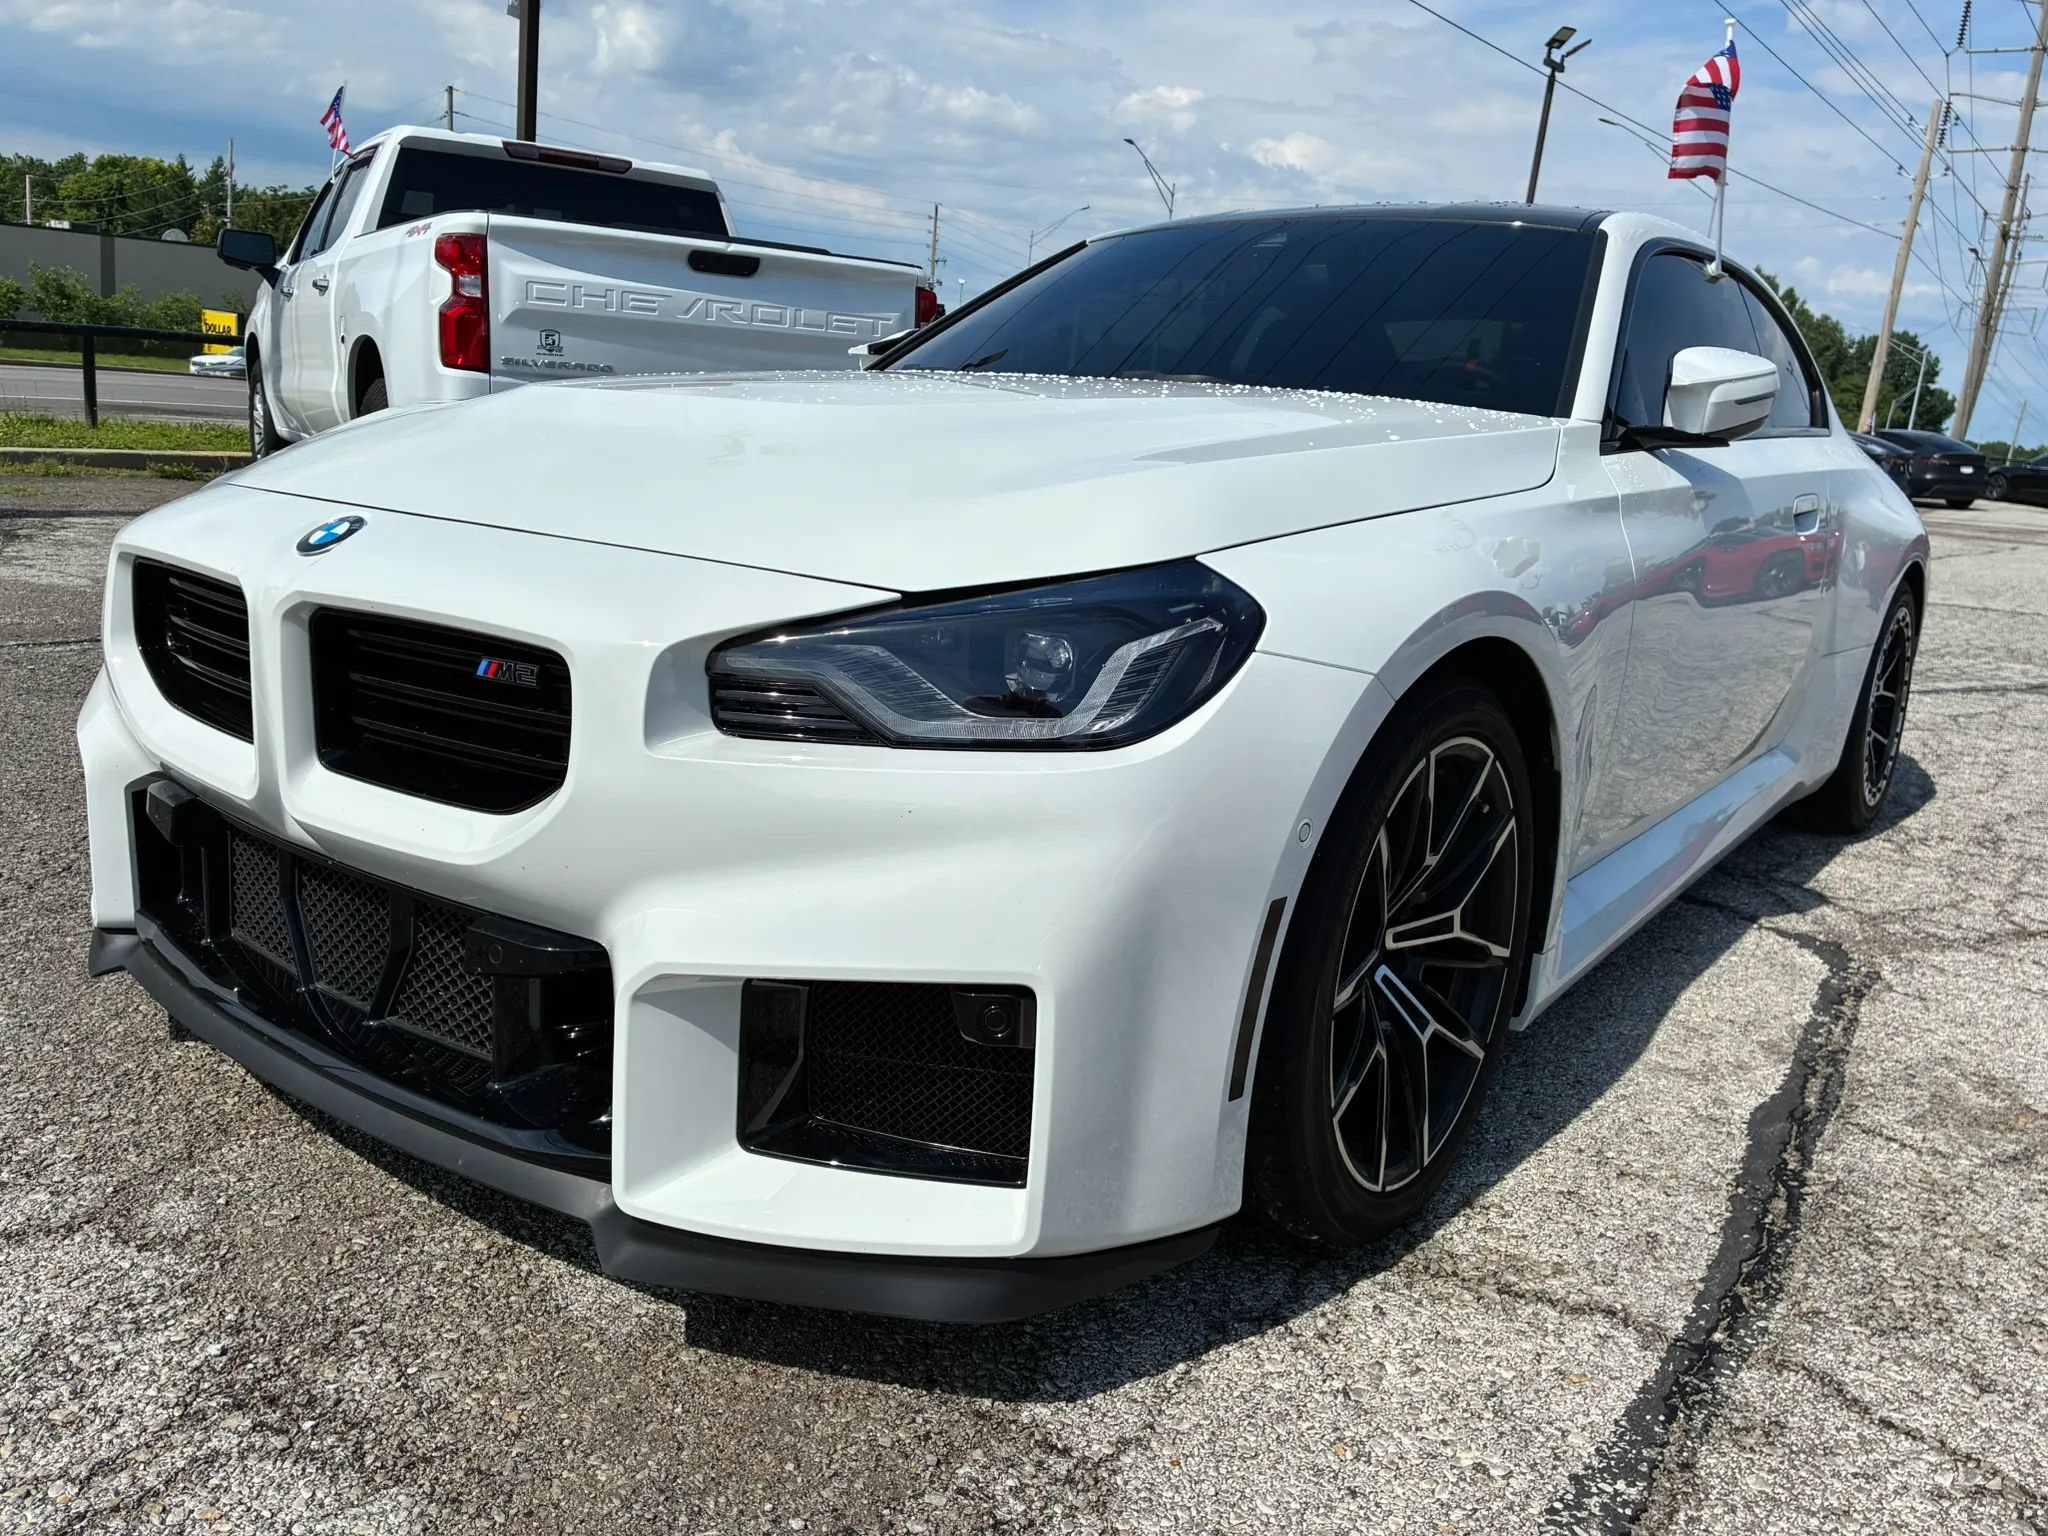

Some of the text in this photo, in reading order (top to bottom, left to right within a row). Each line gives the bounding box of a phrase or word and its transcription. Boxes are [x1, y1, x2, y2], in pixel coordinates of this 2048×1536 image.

[526, 281, 893, 337] CHEVROLET
[205, 322, 232, 336] DOLLAR
[501, 357, 614, 373] SILVERADO
[491, 660, 537, 687] M2
